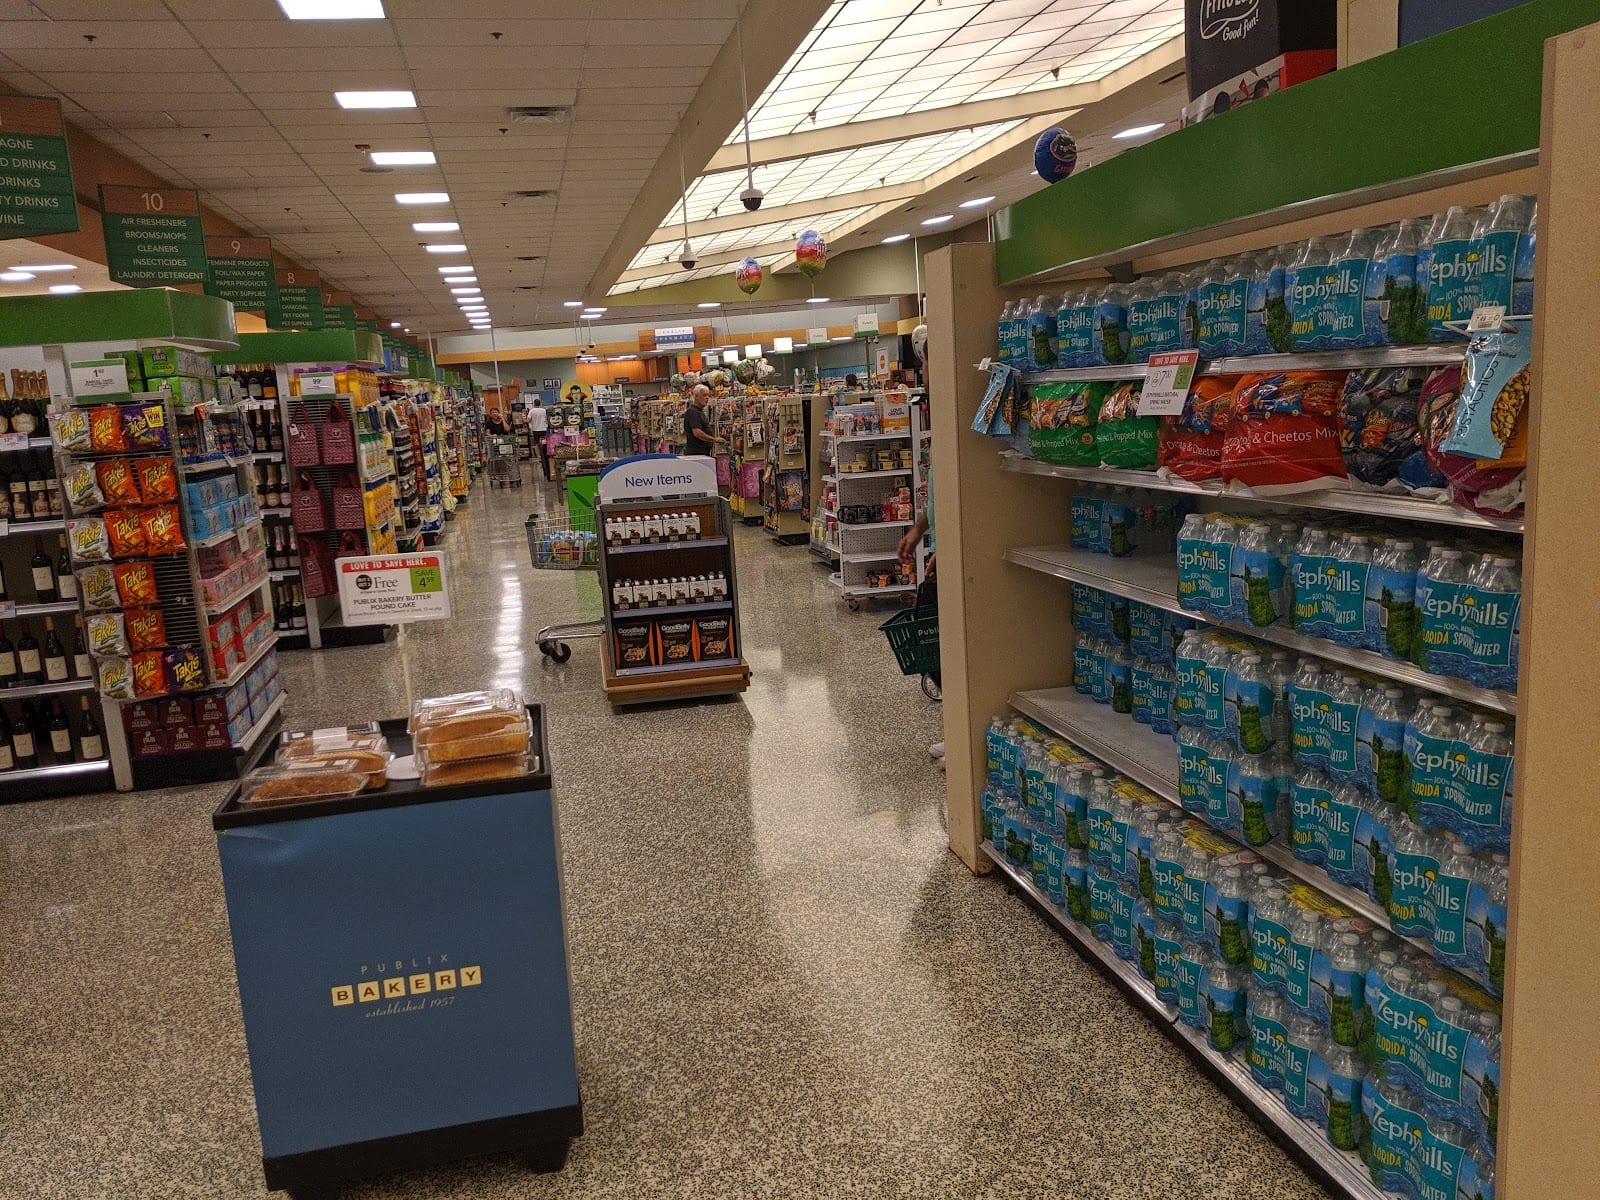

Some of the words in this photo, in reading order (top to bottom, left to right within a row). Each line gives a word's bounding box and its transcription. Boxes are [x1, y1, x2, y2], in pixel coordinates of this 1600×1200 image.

[1222, 22, 1243, 41] Good
[1243, 9, 1260, 39] fun!
[12, 158, 57, 170] DRINKS
[15, 196, 59, 208] DRINKS
[141, 192, 164, 212] 10
[121, 217, 135, 225] AIR
[136, 217, 187, 227] FRESHENERS
[125, 230, 187, 240] BROOMS/MOPS
[137, 244, 179, 253] CLEANERS
[230, 240, 241, 254] 9
[132, 258, 187, 267] INSECTICIDES
[117, 271, 156, 279] LAUNDRY
[157, 272, 204, 280] DETERGENT
[287, 272, 296, 284] 8
[326, 294, 332, 303] 7
[1428, 303, 1451, 320] RIDA
[1291, 319, 1314, 334] RIDA
[1456, 360, 1499, 437] PISTACHIOS
[56, 416, 84, 441] Takis
[93, 417, 113, 437] Takis
[1253, 432, 1261, 444] &
[1263, 430, 1312, 444] Cheetos
[1316, 427, 1340, 439] Mix
[1114, 432, 1136, 442] Popped
[1138, 431, 1154, 440] Mix
[103, 465, 125, 490] Takis
[143, 464, 169, 485] Takis
[625, 476, 655, 488] New
[657, 474, 693, 486] Items
[69, 472, 90, 497] Takis
[113, 515, 140, 541] Takis
[147, 513, 173, 536] Takis
[74, 524, 102, 547] Takis
[350, 561, 369, 570] LOVE
[385, 560, 403, 568] SAVE
[405, 558, 427, 566] HERE.
[84, 572, 111, 596] Takis
[120, 566, 148, 591] Takis
[374, 576, 398, 588] Free
[371, 603, 396, 611] POUND
[130, 615, 157, 637] Takis
[618, 627, 648, 635] GoodBelly
[661, 623, 691, 632] GoodBelly
[699, 620, 728, 628] GoodBelly
[90, 621, 117, 647] Takis
[133, 657, 156, 679] Takis
[173, 655, 201, 683] Takis
[361, 953, 448, 975] PUBLIX
[334, 967, 480, 1004] BAKERY
[365, 998, 425, 1018] established
[430, 996, 456, 1009] 1957
